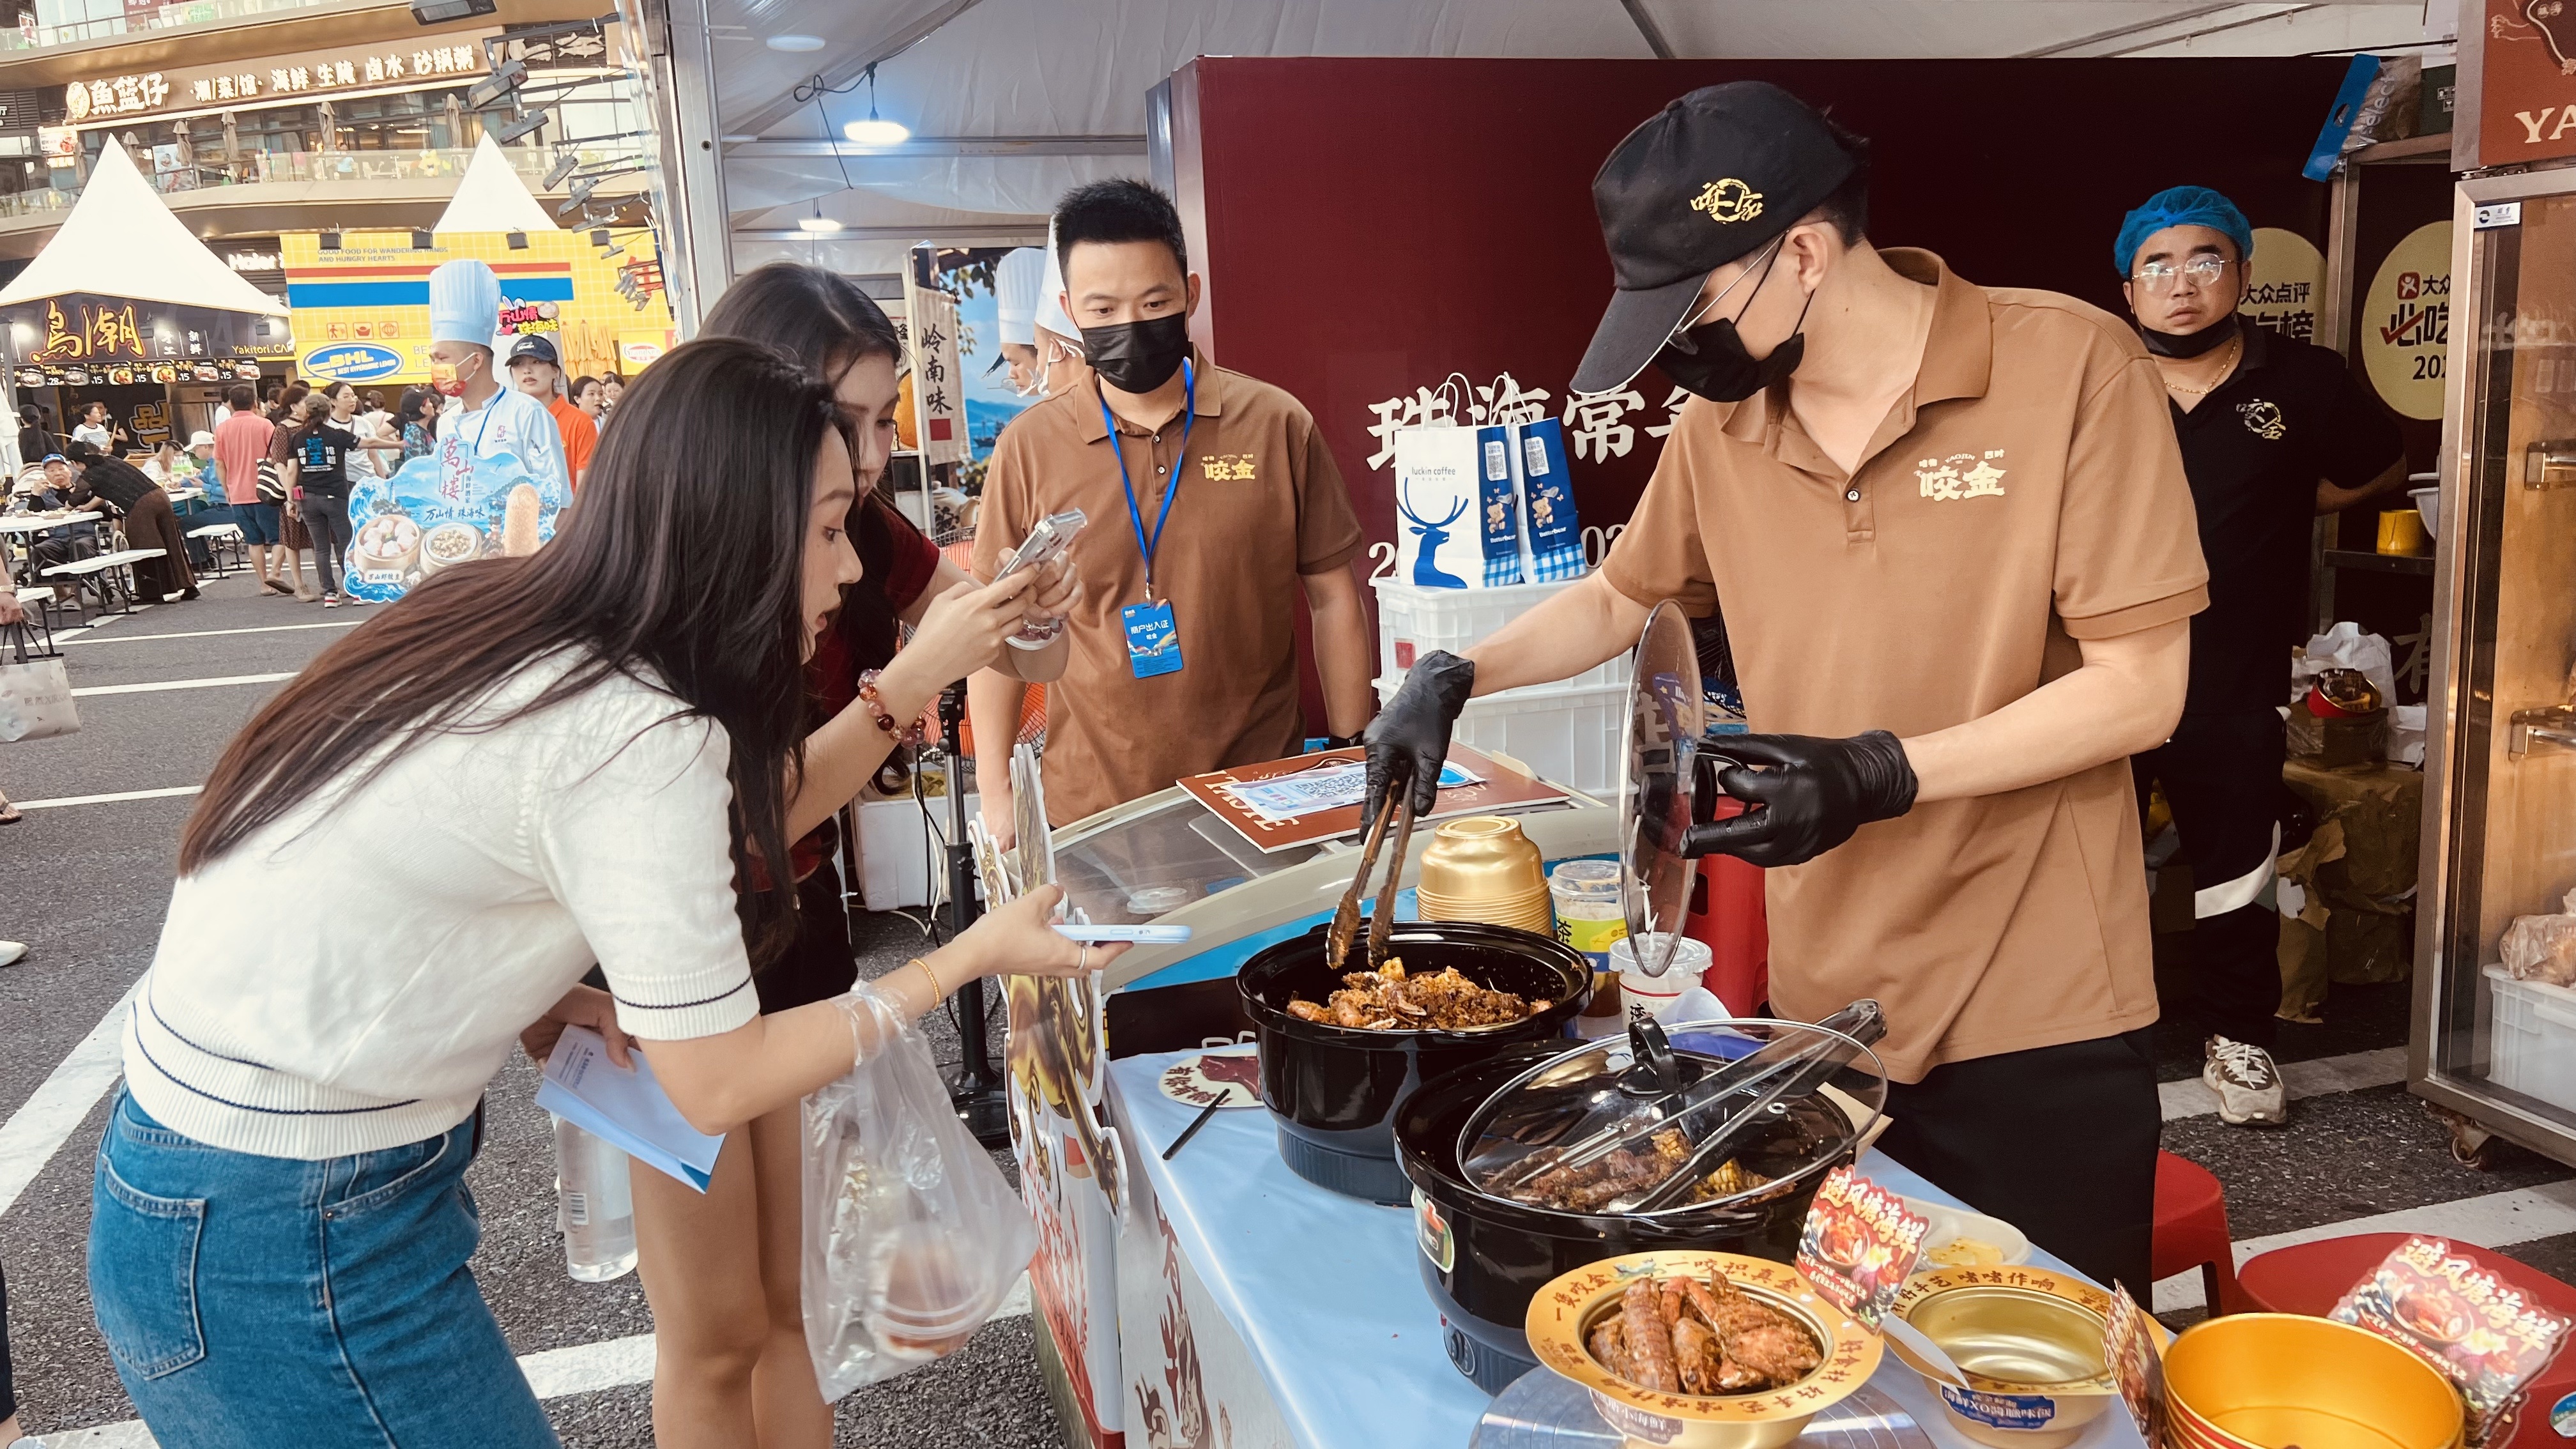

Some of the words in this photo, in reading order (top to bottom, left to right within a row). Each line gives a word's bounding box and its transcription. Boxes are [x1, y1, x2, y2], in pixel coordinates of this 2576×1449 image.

[2240, 282, 2310, 305] 大众点评
[518, 318, 559, 335] 珠海味
[188, 330, 203, 355] 新鲜
[330, 350, 374, 368] BHL
[921, 323, 953, 415] 岭南味
[1204, 459, 1255, 481] 咬金
[1412, 466, 1431, 475] luckin
[1434, 466, 1455, 475] coffee
[1919, 461, 2007, 502] 咬金
[457, 505, 486, 519] 珠海味
[1130, 620, 1169, 635] 商户出入证
[1820, 1170, 1925, 1266] 避风塘海鲜
[2395, 1238, 2559, 1357] 避风塘海鲜
